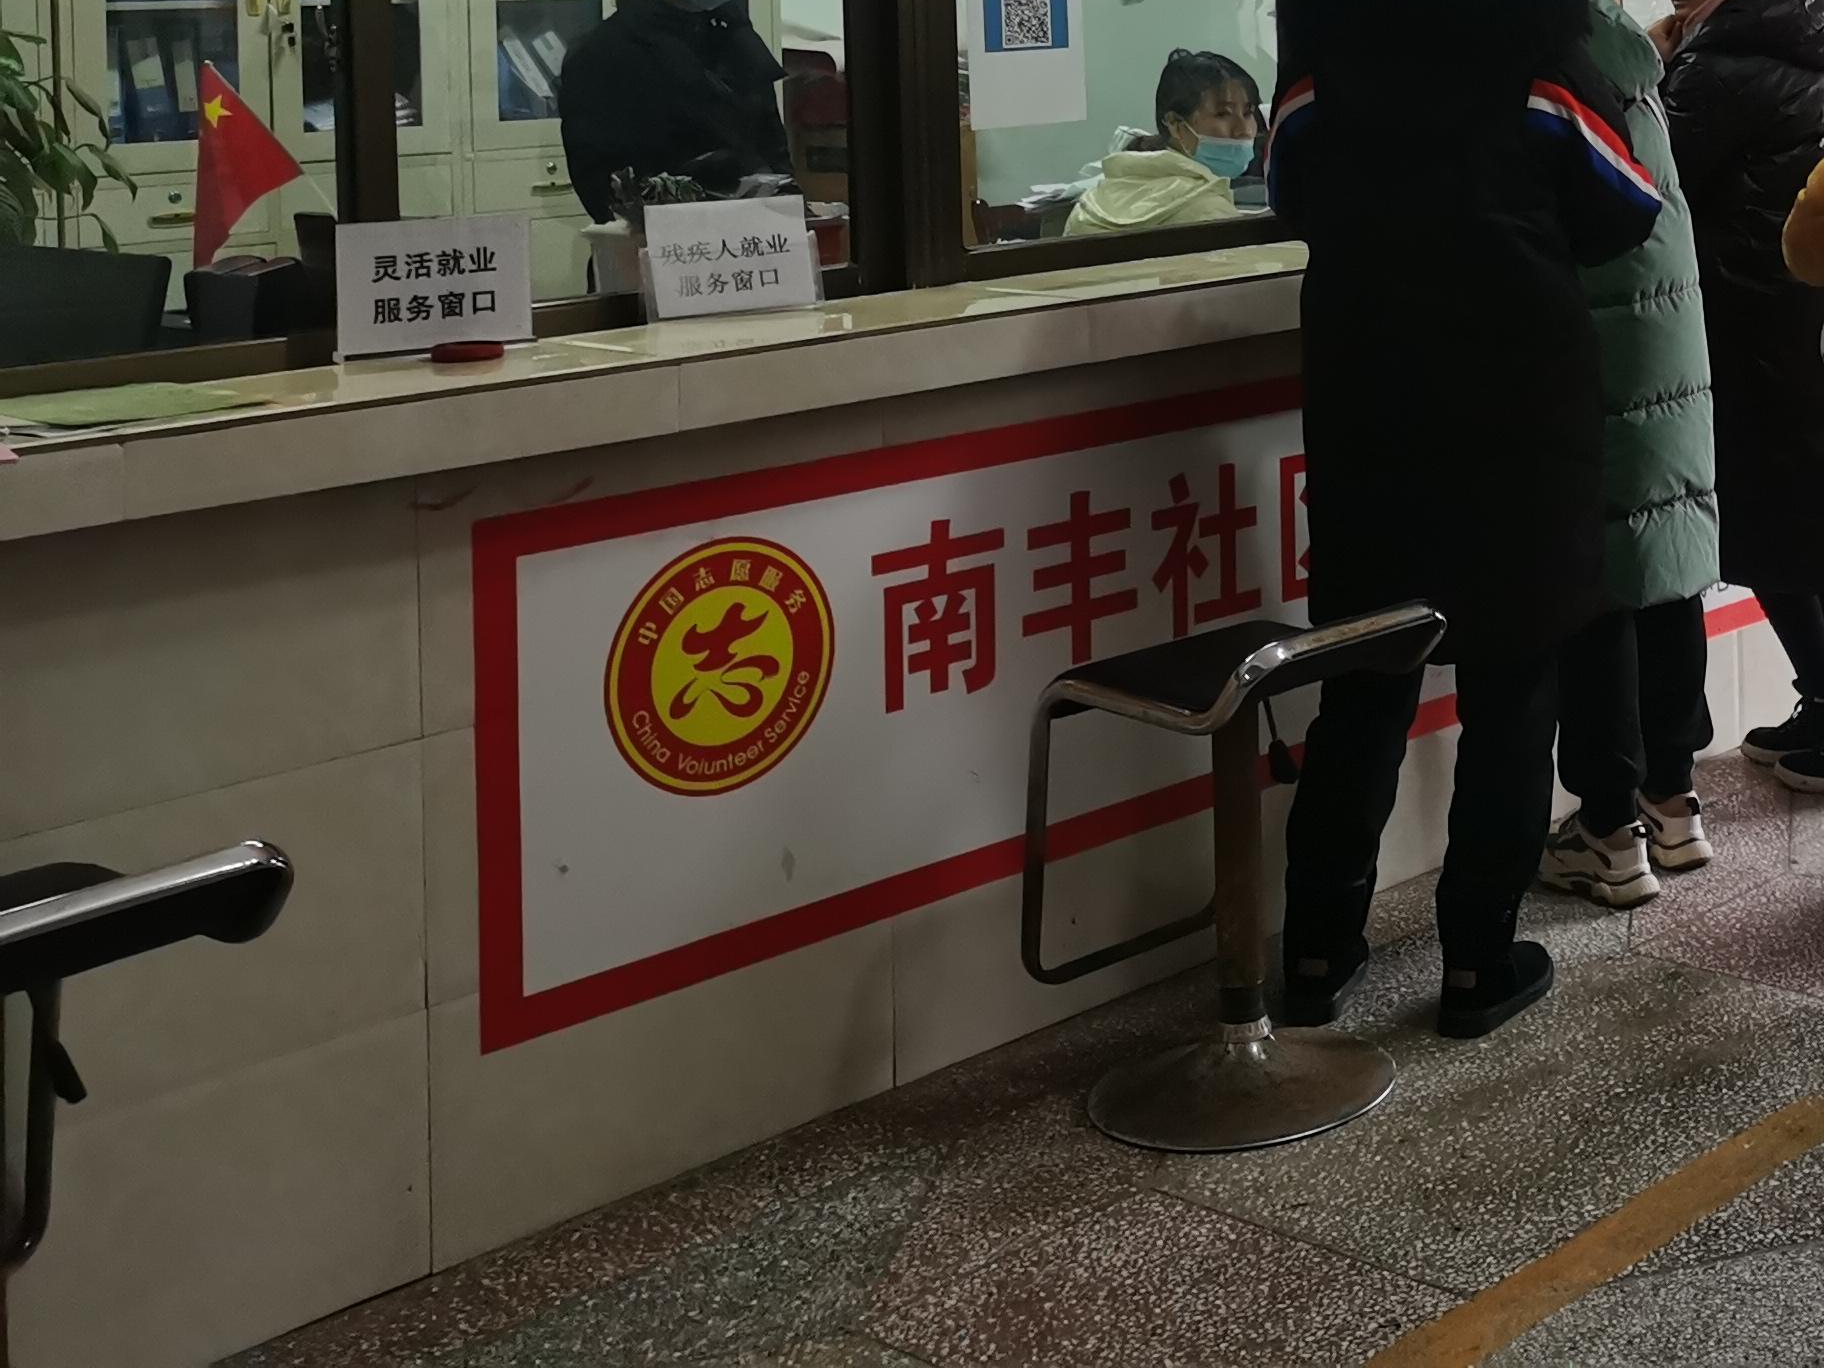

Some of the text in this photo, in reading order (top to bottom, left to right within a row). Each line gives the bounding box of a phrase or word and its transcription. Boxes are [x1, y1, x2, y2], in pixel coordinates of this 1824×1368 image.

[371, 246, 498, 283] 灵活就业
[660, 233, 790, 266] 残疾人就业
[678, 267, 781, 297] 服务窗口
[372, 288, 498, 325] 服务窗口
[637, 558, 807, 645] 中国志愿服务
[871, 453, 1308, 714] 南丰社
[632, 670, 810, 775] China Volunteer Service
